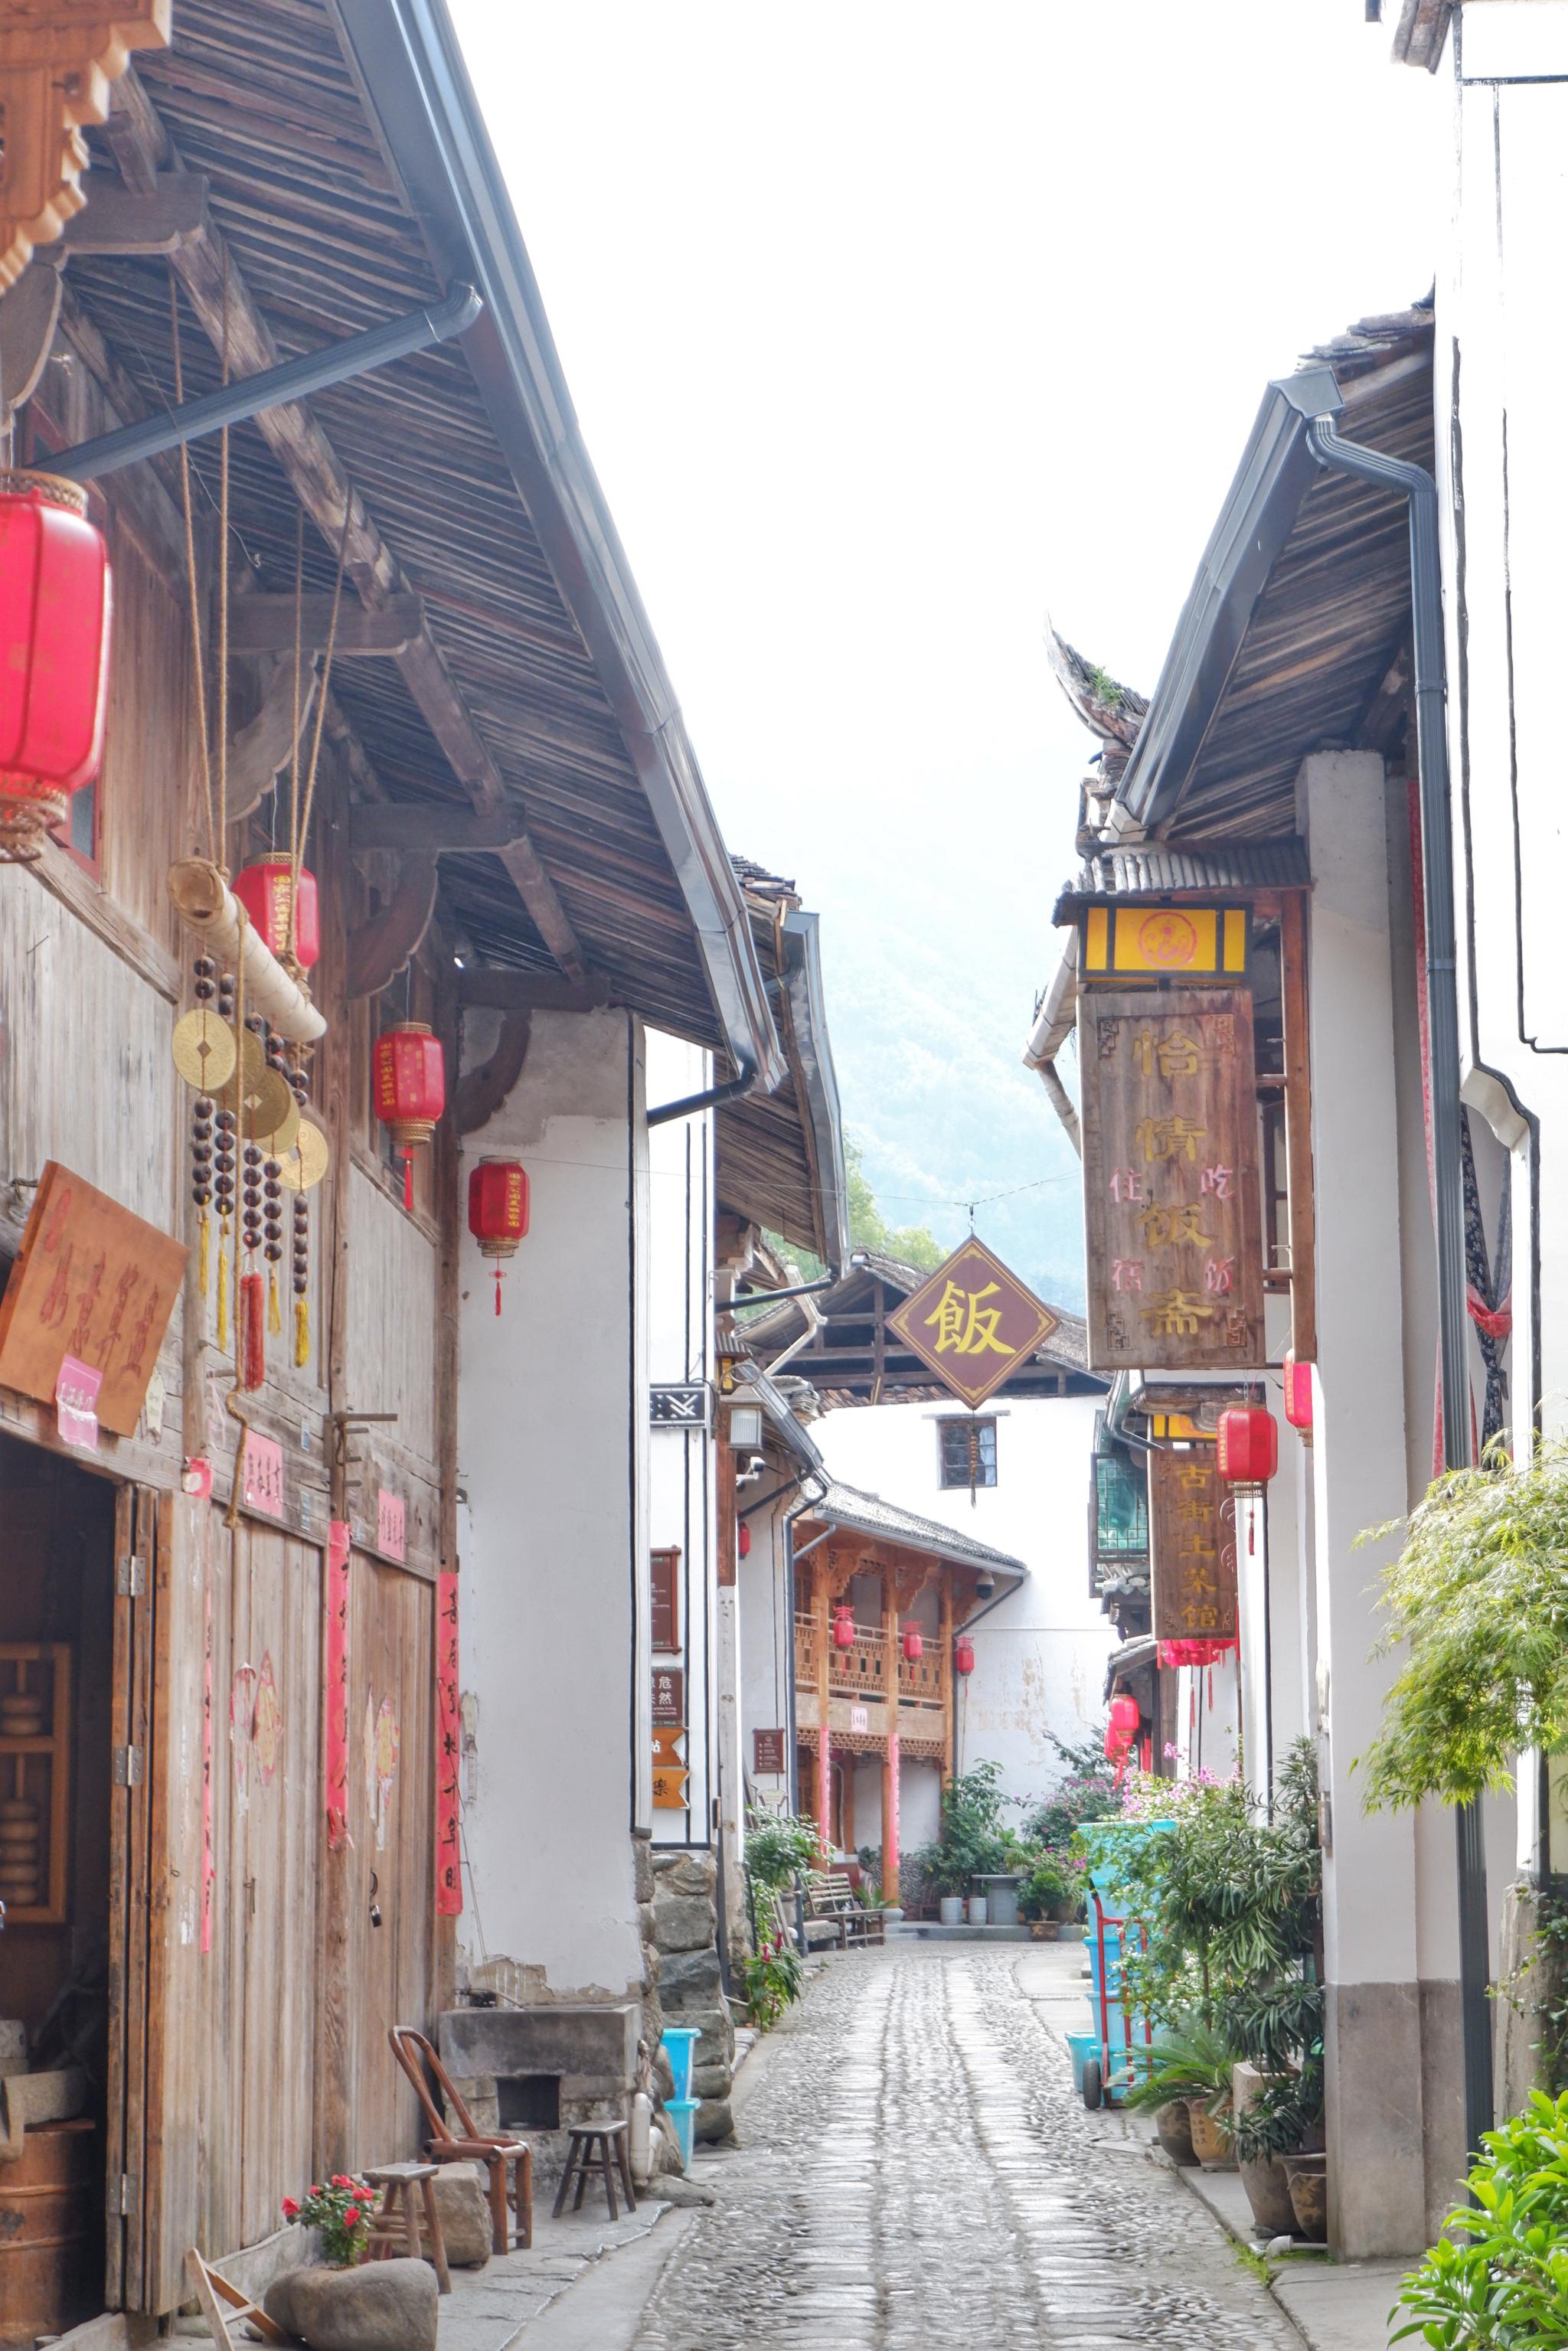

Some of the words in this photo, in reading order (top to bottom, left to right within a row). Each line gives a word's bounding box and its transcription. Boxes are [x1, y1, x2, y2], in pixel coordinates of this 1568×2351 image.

[1110, 1167, 1145, 1291] 住宿
[1132, 1029, 1213, 1335] 怡情饭斋
[1200, 1163, 1235, 1292] 吃饭
[923, 1279, 1017, 1354] 飯
[1176, 1464, 1218, 1628] 古街土菜馆
